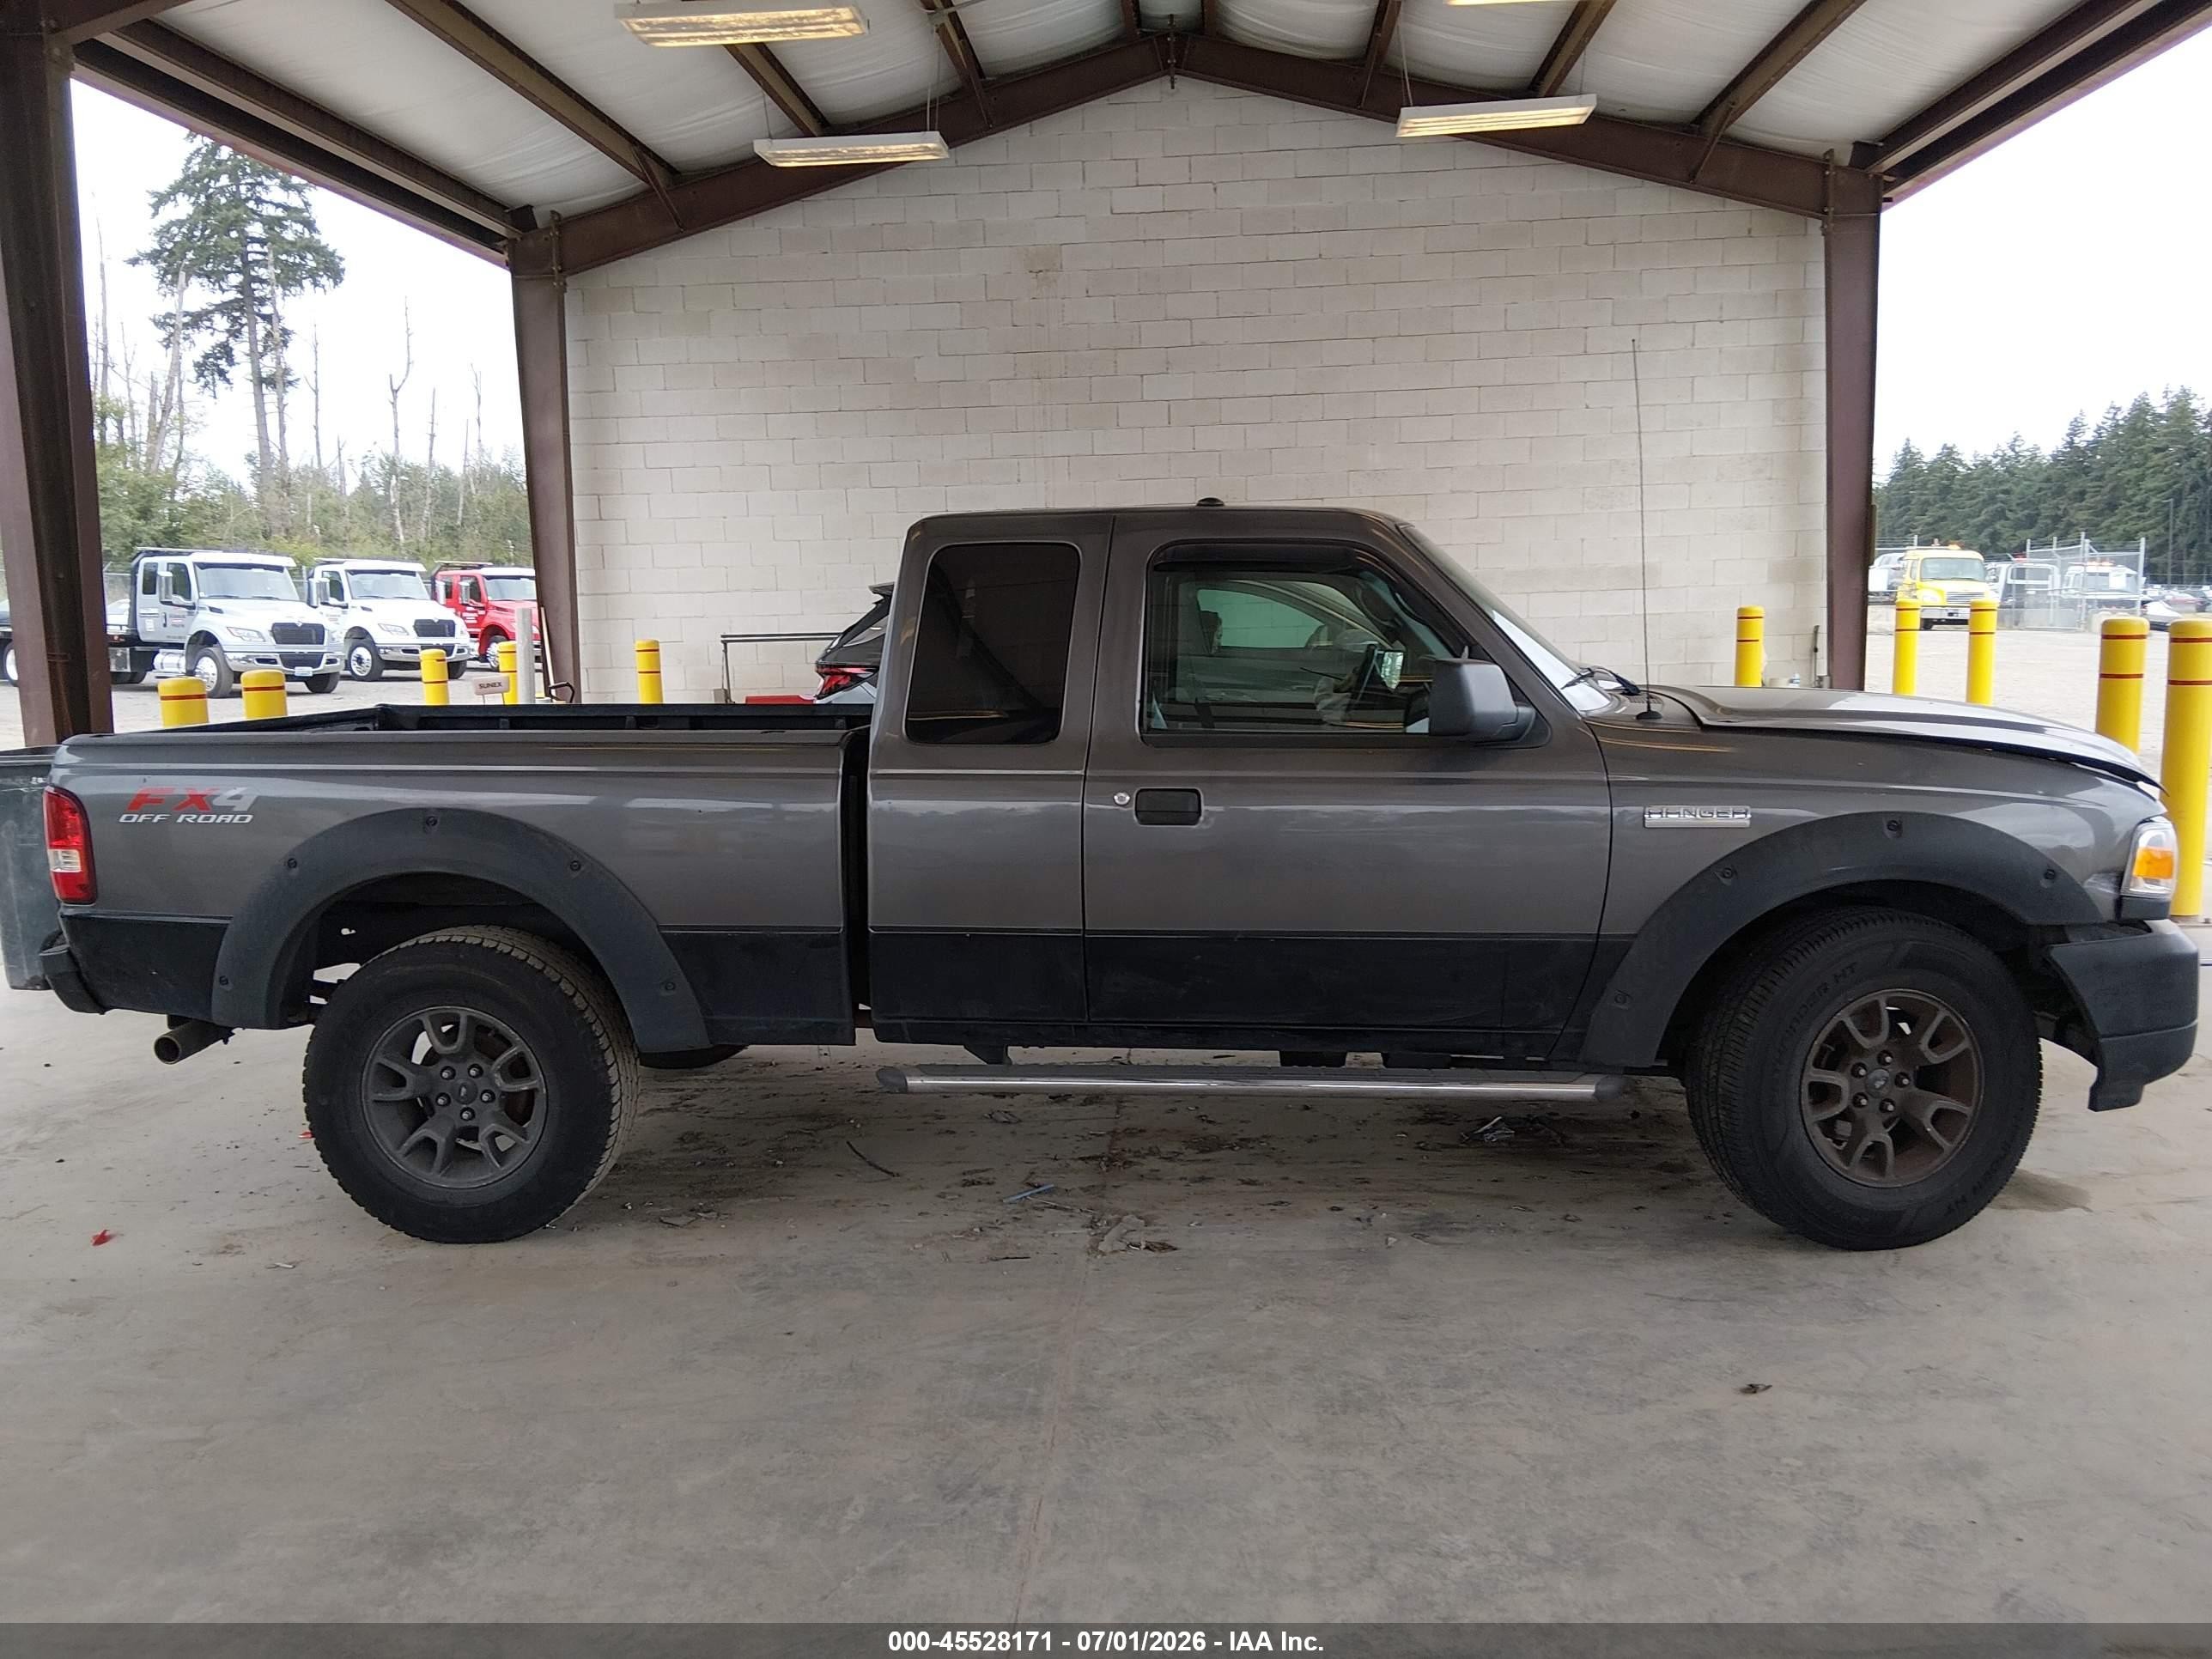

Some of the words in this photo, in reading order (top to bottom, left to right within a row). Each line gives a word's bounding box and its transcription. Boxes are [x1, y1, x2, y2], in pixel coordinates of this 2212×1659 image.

[128, 787, 258, 811] FX4
[118, 813, 172, 823] OFF
[176, 814, 254, 824] ROAD
